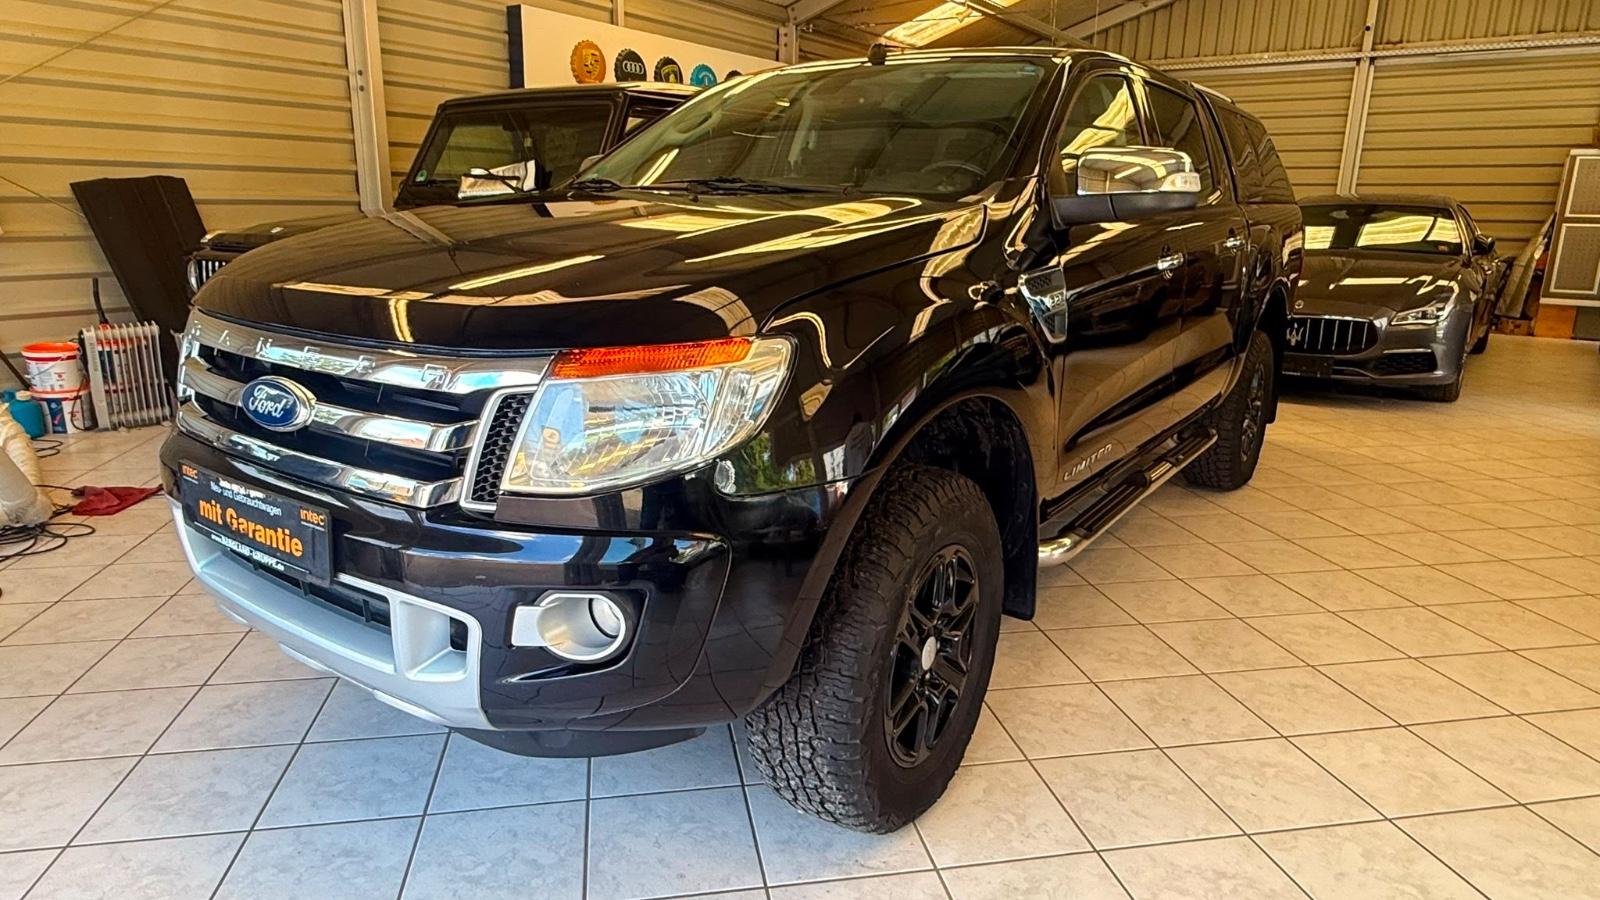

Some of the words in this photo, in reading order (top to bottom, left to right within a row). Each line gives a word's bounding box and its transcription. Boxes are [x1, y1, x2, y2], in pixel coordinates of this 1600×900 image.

[248, 385, 285, 418] Ford
[181, 465, 198, 479] intec
[223, 488, 233, 498] und
[234, 491, 282, 517] Gebrauchtwagen
[300, 508, 325, 526] intec
[199, 499, 223, 525] mit
[226, 507, 304, 557] Garantie
